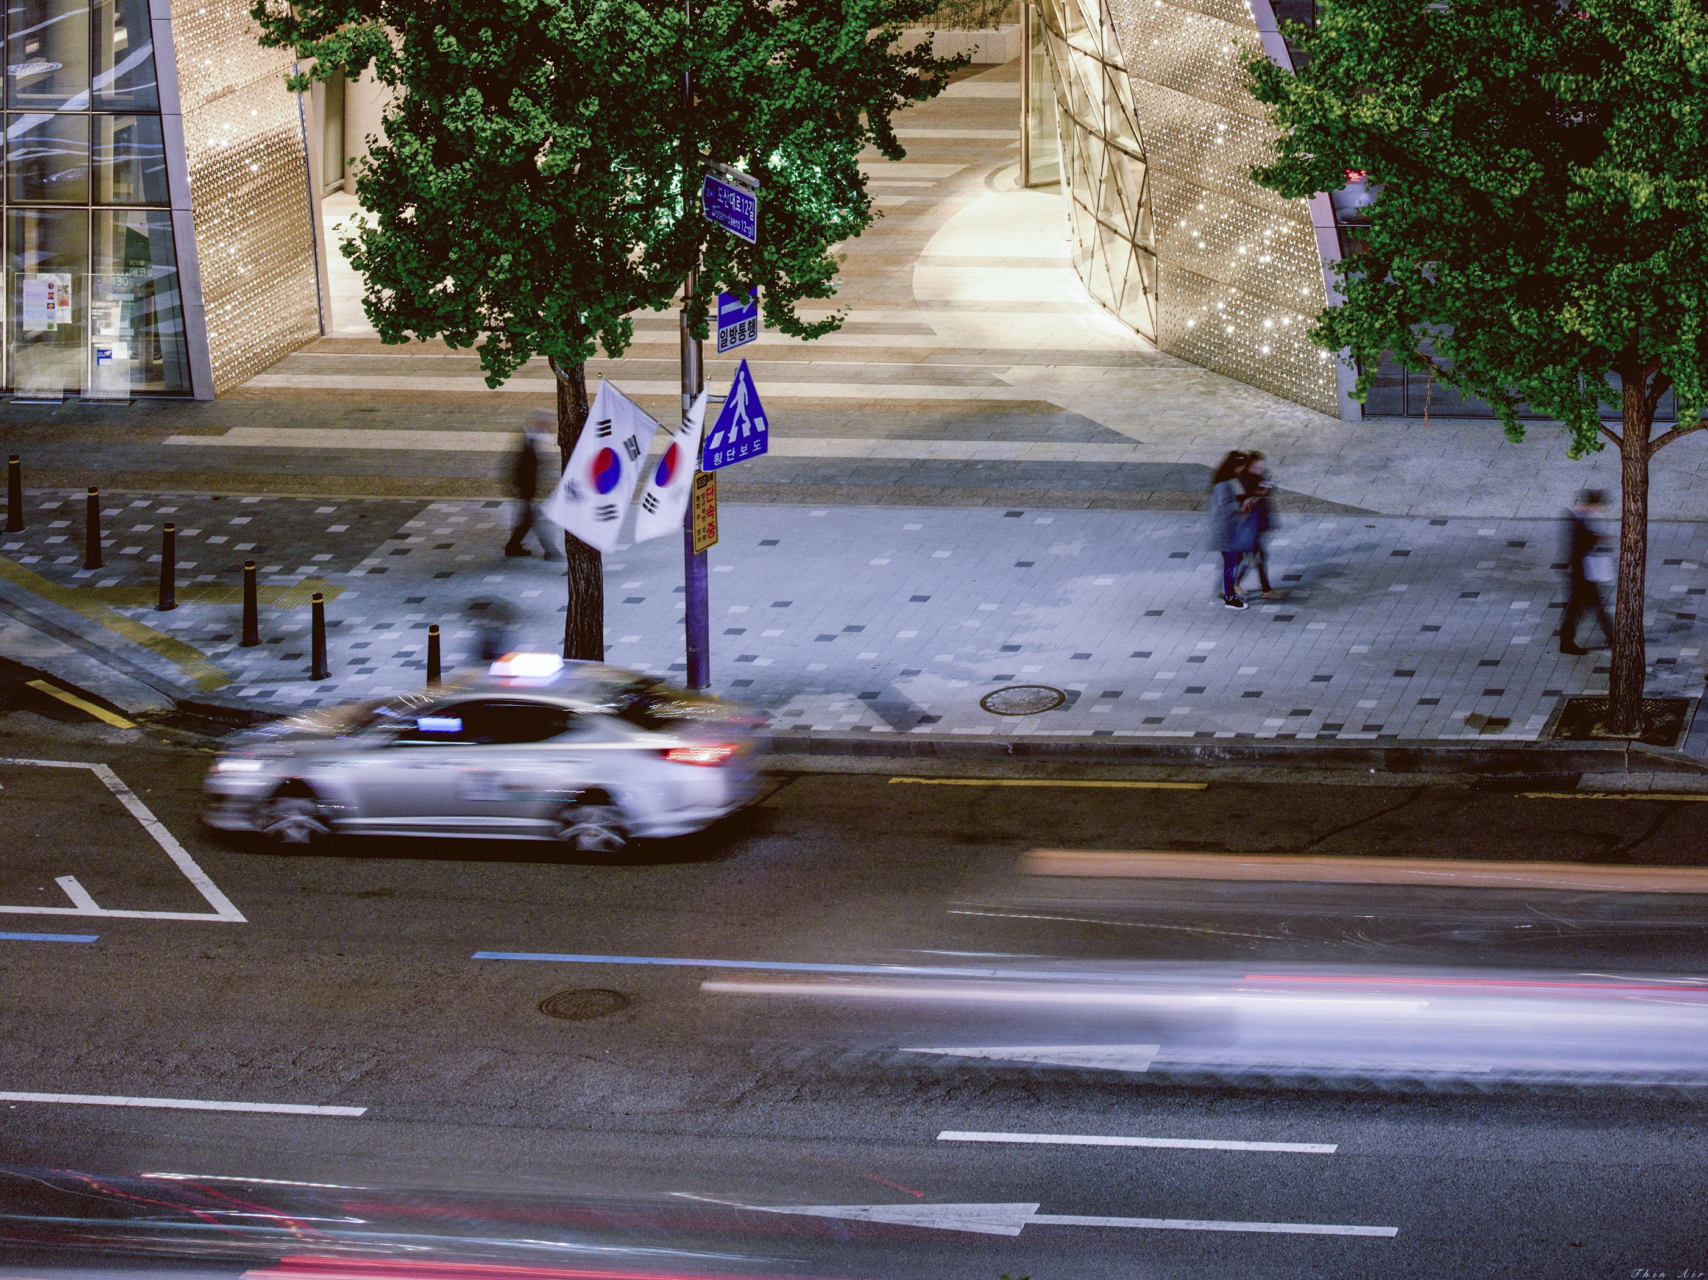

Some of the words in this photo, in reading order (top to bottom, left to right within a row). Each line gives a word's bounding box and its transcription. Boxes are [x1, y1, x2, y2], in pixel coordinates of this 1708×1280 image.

[717, 187, 755, 222] 도산대로12길
[741, 219, 754, 238] 12-gil
[111, 277, 129, 287] 130
[720, 318, 756, 349] 일방통행
[713, 439, 762, 466] 횡단보도
[705, 484, 716, 540] 단속중
